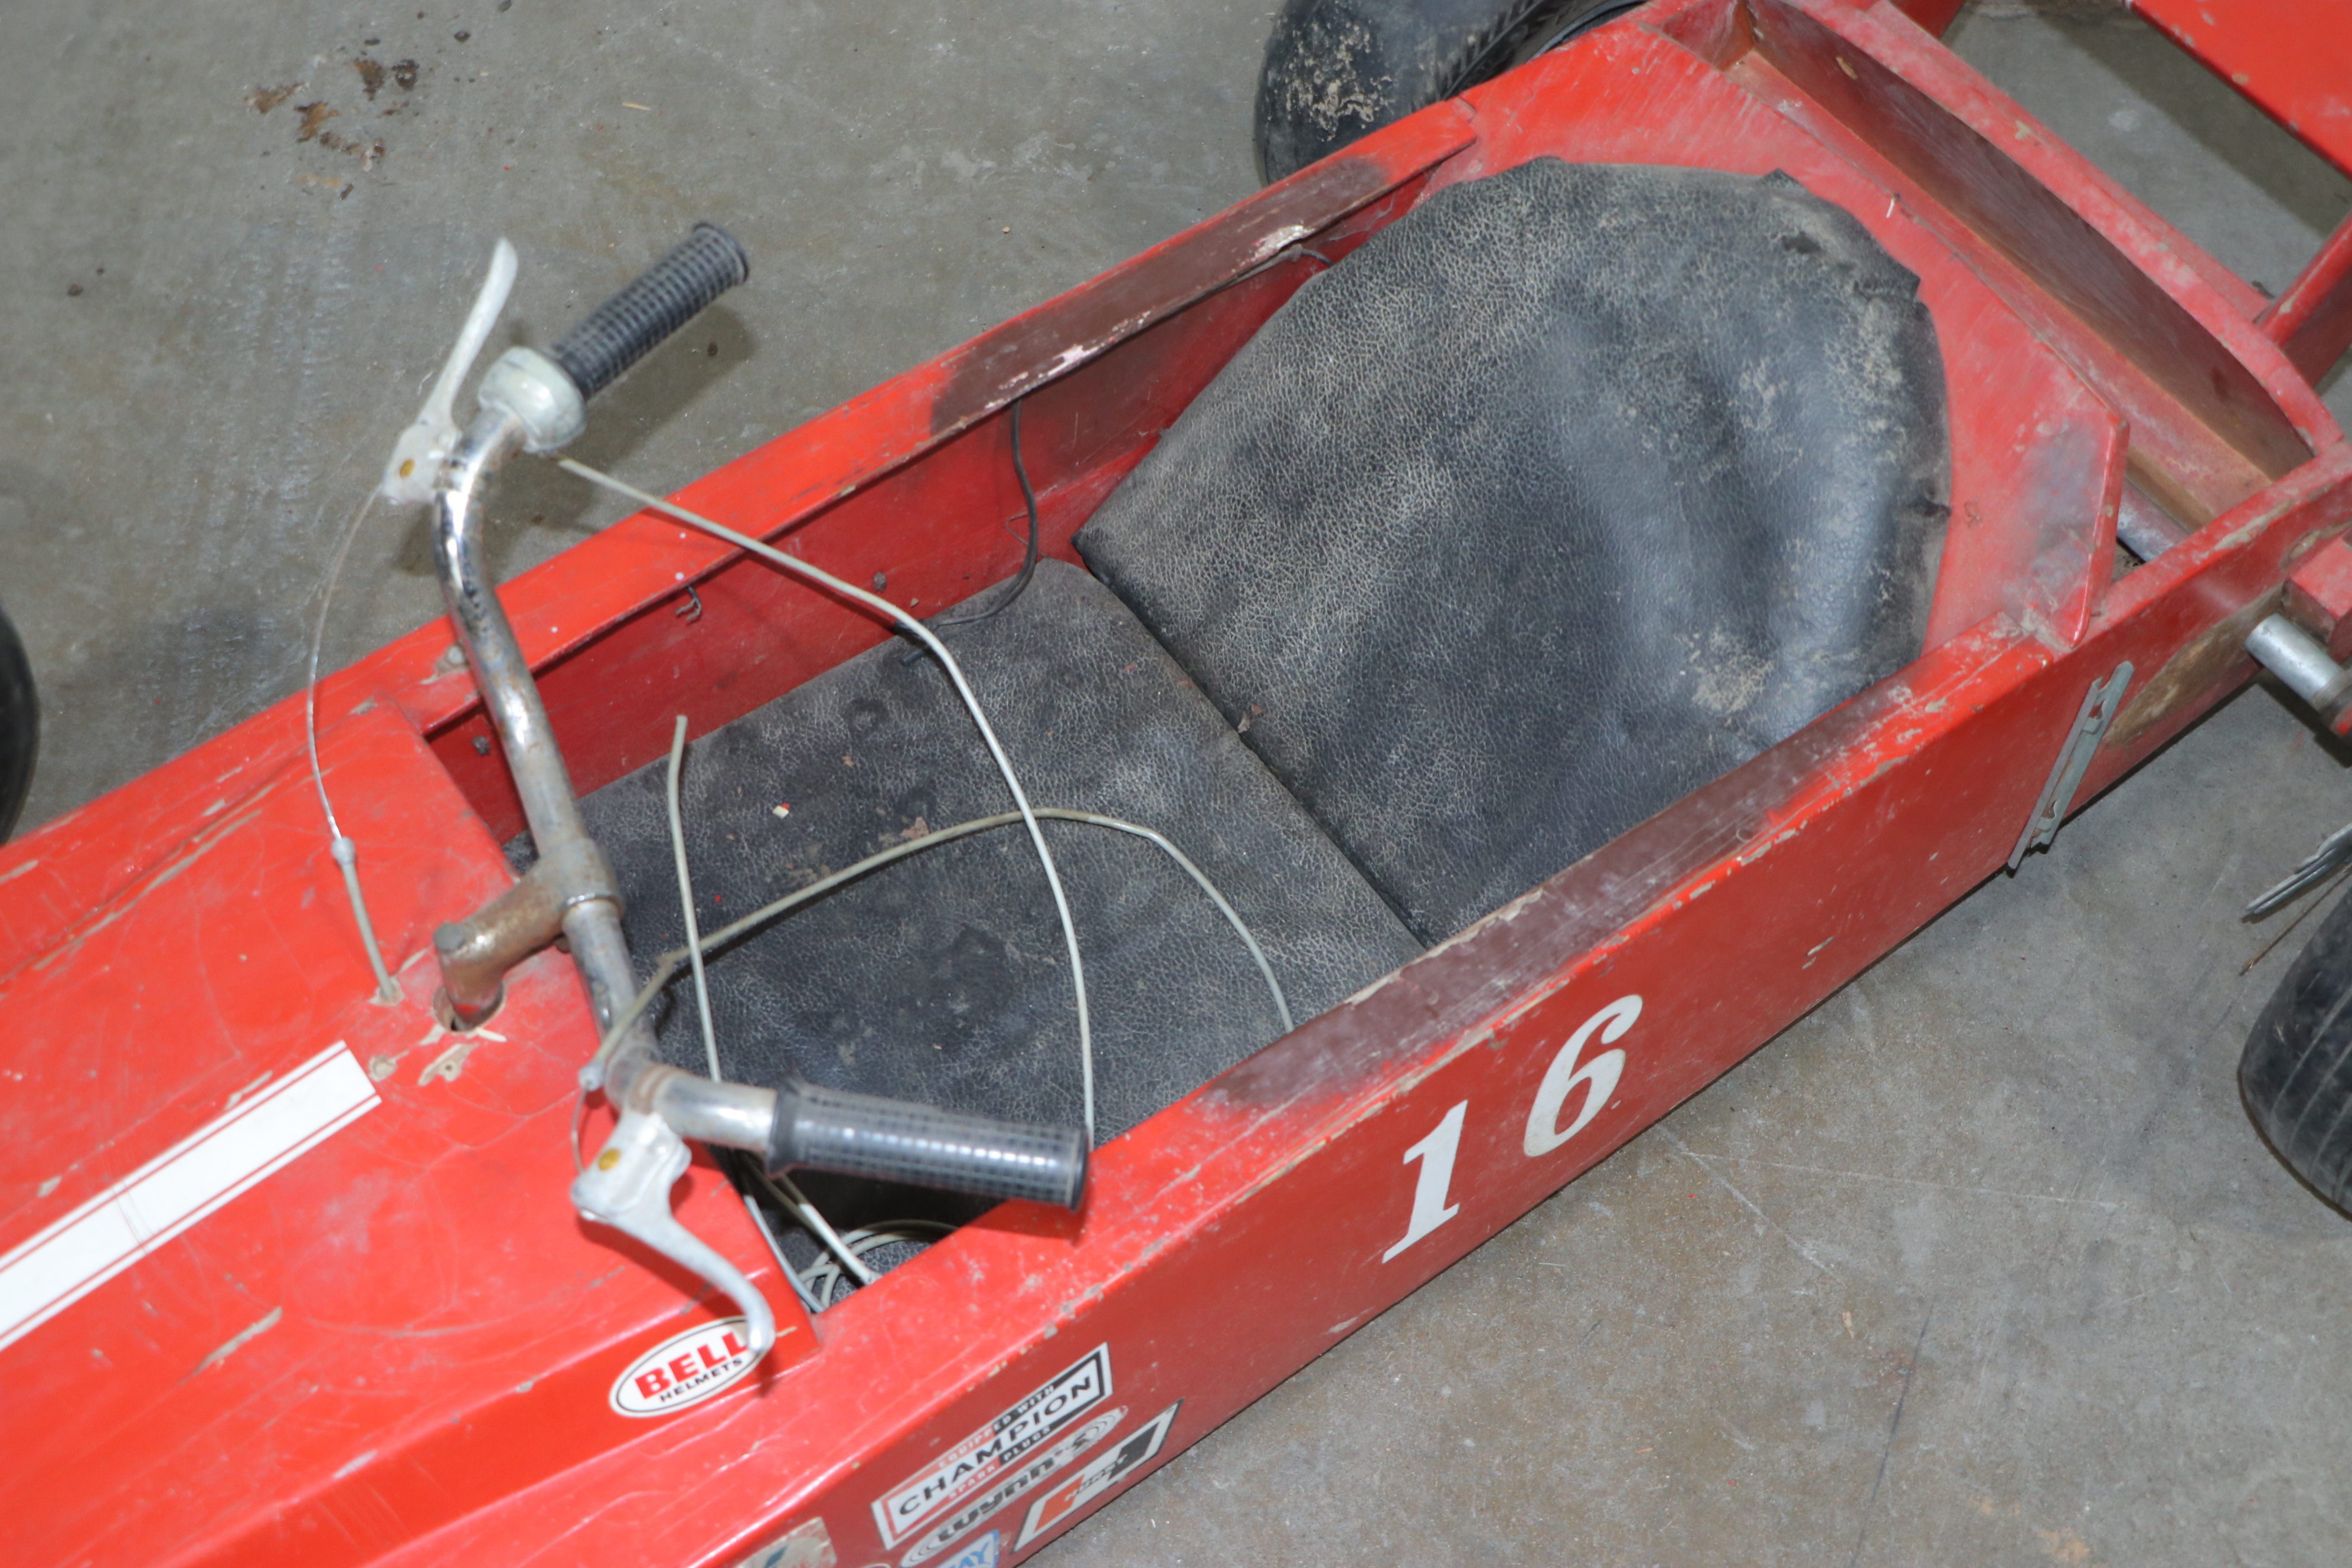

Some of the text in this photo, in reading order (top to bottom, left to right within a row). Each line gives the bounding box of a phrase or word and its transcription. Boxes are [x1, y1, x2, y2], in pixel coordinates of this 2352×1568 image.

[635, 1332, 747, 1399] BELL
[659, 1358, 743, 1402] HELMETS
[899, 1376, 1090, 1515] CHAMPION
[939, 1385, 1054, 1468] EQUIPPED WITH
[949, 1426, 1051, 1499] SPARK PLUGS
